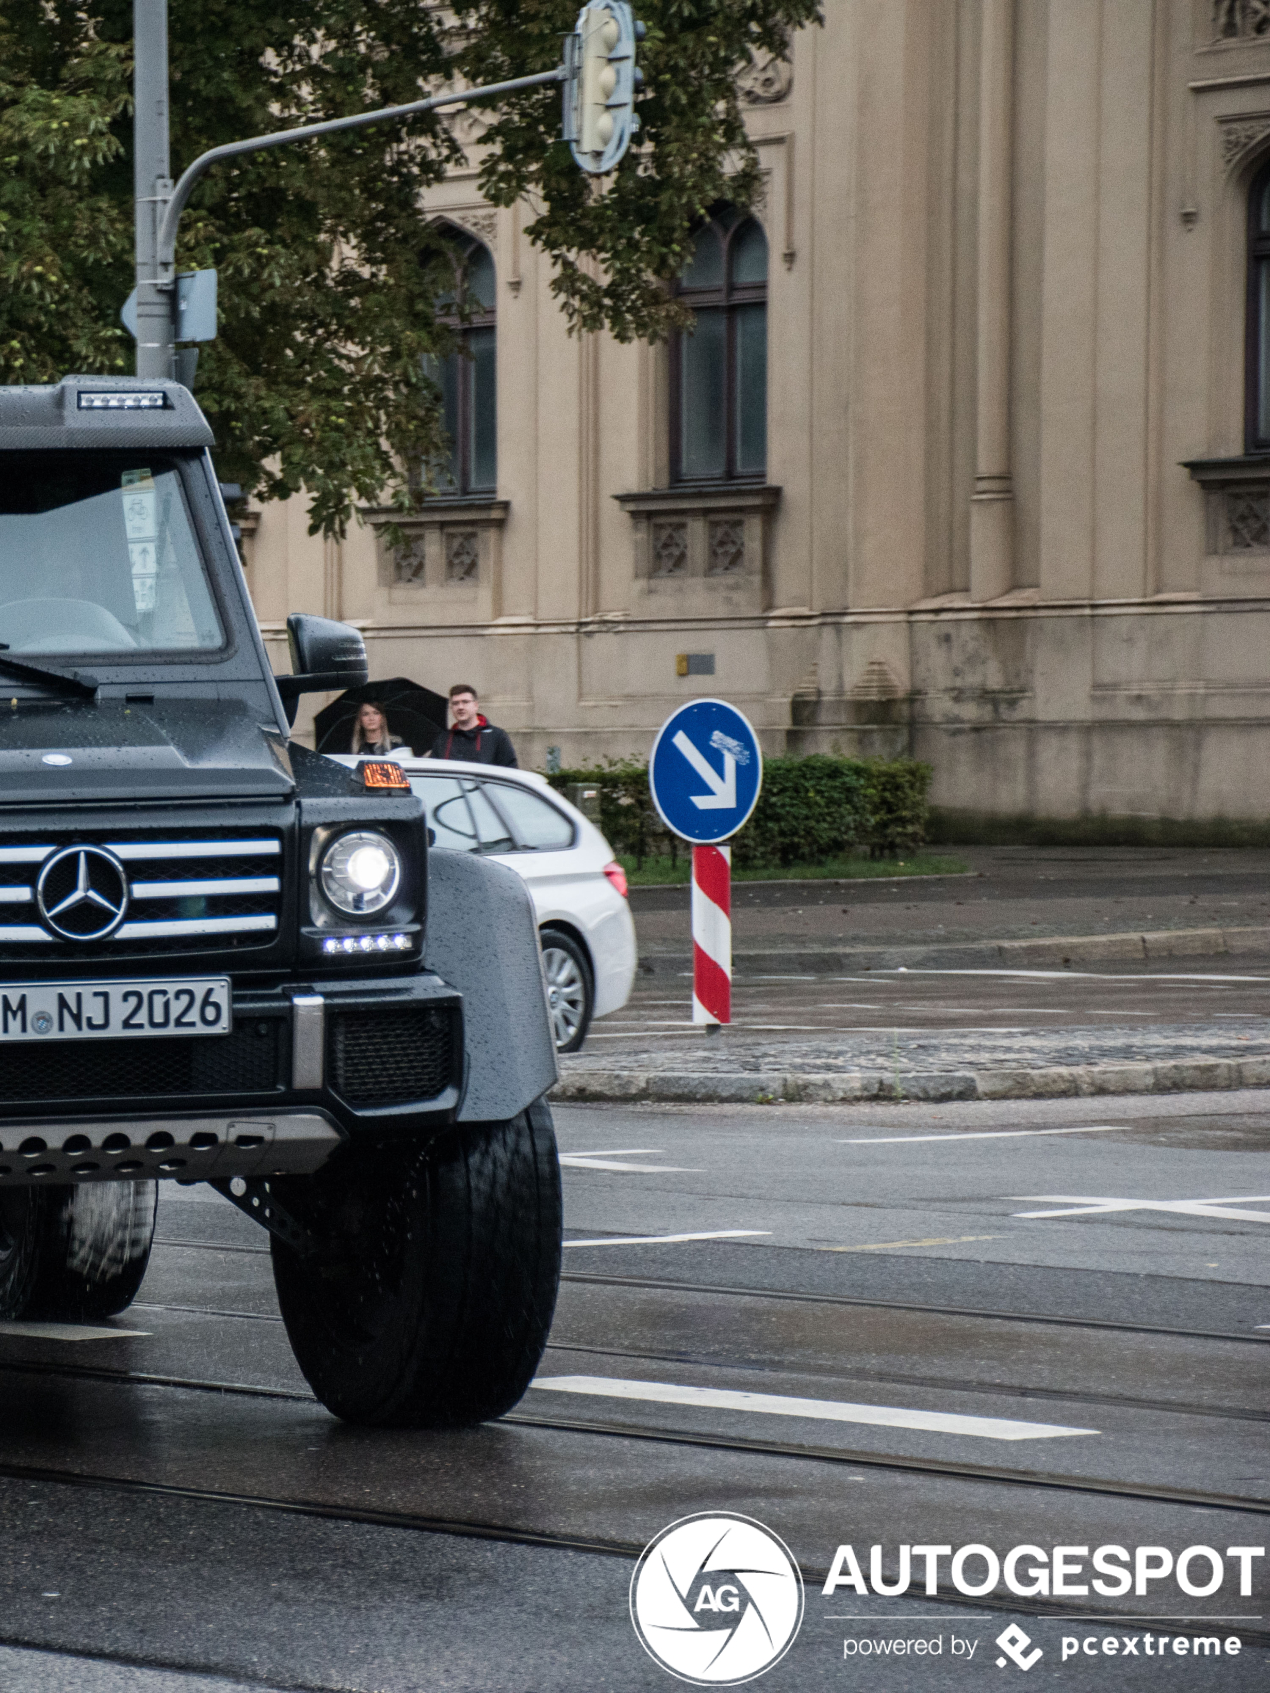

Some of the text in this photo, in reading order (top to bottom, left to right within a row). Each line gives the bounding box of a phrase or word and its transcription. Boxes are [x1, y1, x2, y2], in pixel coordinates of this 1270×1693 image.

[1, 987, 222, 1033] M NJ 2026
